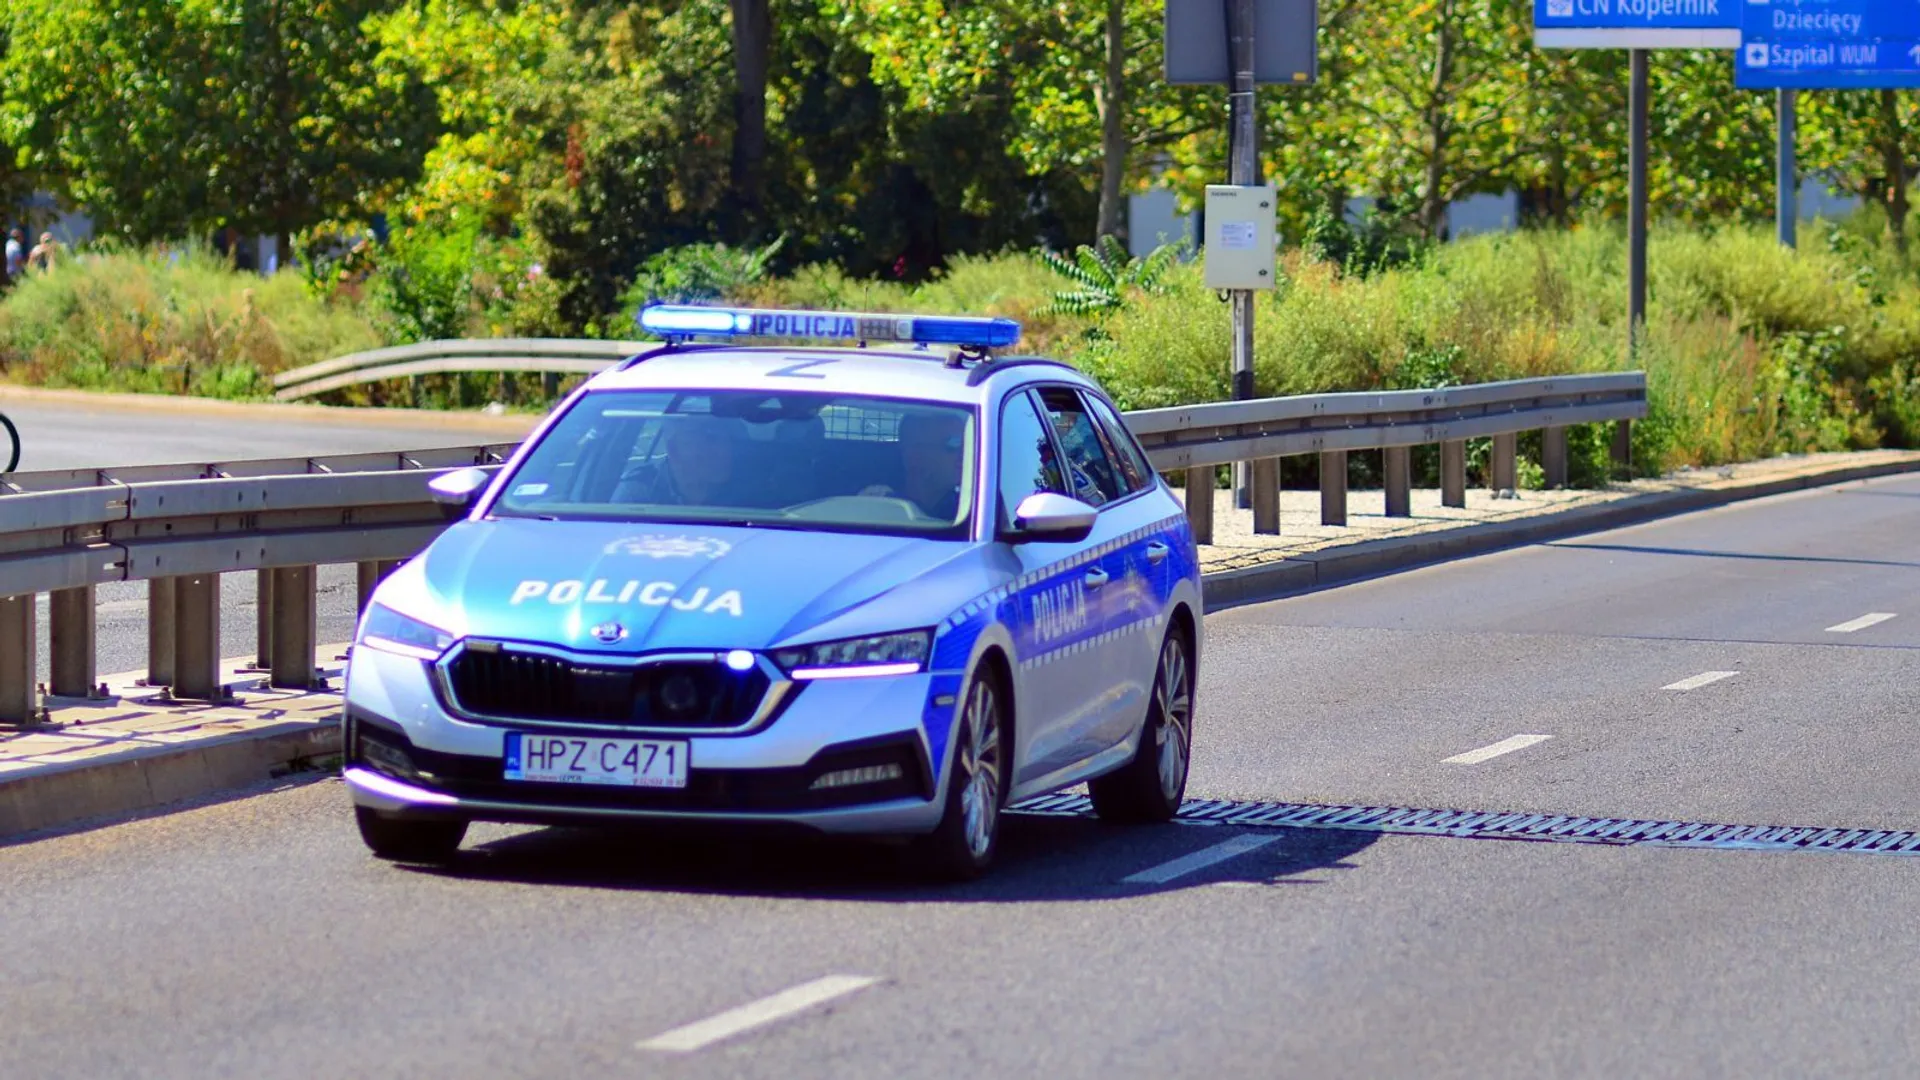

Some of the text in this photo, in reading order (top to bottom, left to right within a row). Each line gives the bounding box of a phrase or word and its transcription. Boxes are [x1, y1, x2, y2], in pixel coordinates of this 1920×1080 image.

[1577, 0, 1719, 21] CN Kopernik
[1772, 8, 1863, 35] Dziecięcy
[1771, 43, 1877, 69] Szpital WUM
[758, 313, 856, 338] POLICJA
[509, 578, 743, 617] POLICJA
[1032, 577, 1087, 645] POLICJA
[527, 737, 676, 776] HPZ C471
